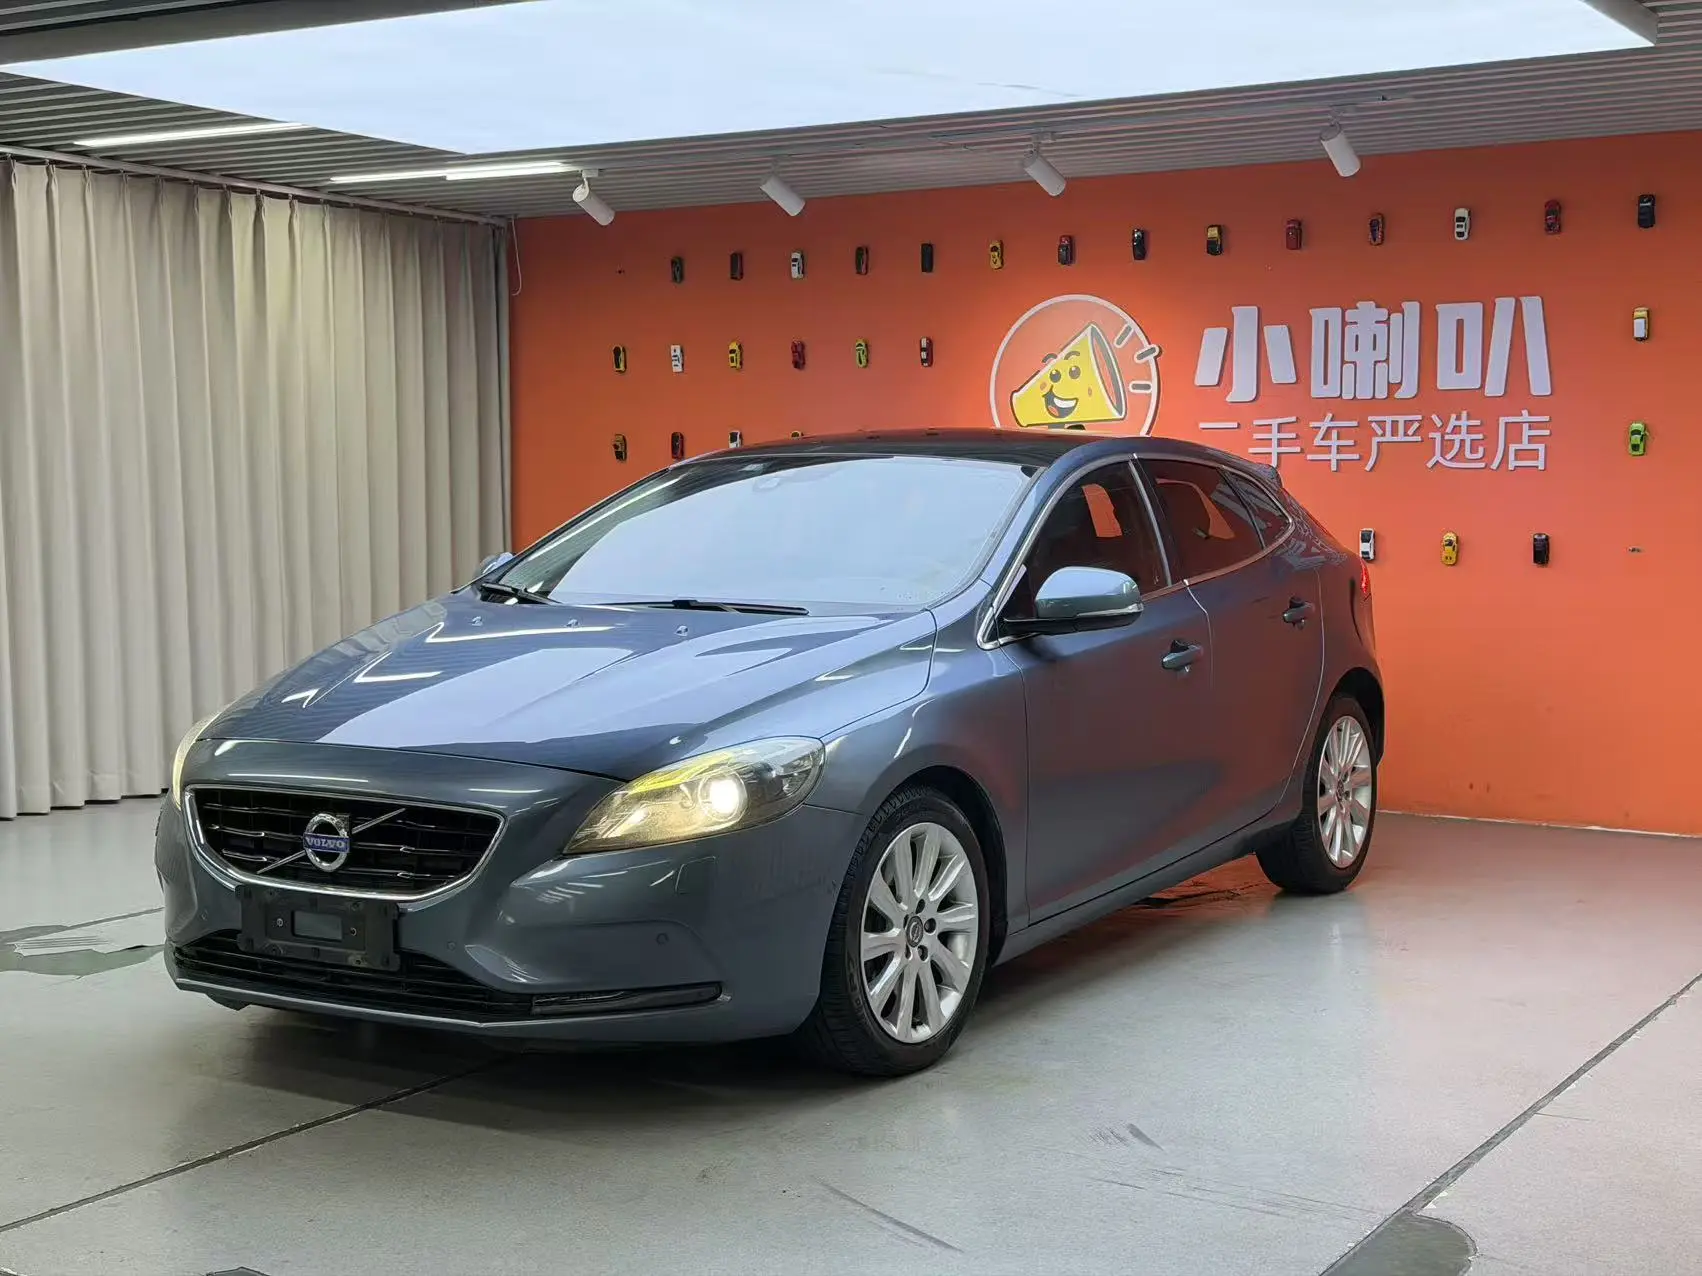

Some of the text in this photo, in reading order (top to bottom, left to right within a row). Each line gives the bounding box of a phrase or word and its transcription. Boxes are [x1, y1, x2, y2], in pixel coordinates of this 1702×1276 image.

[1194, 296, 1552, 402] 小喇叭
[305, 836, 346, 849] VOLVO
